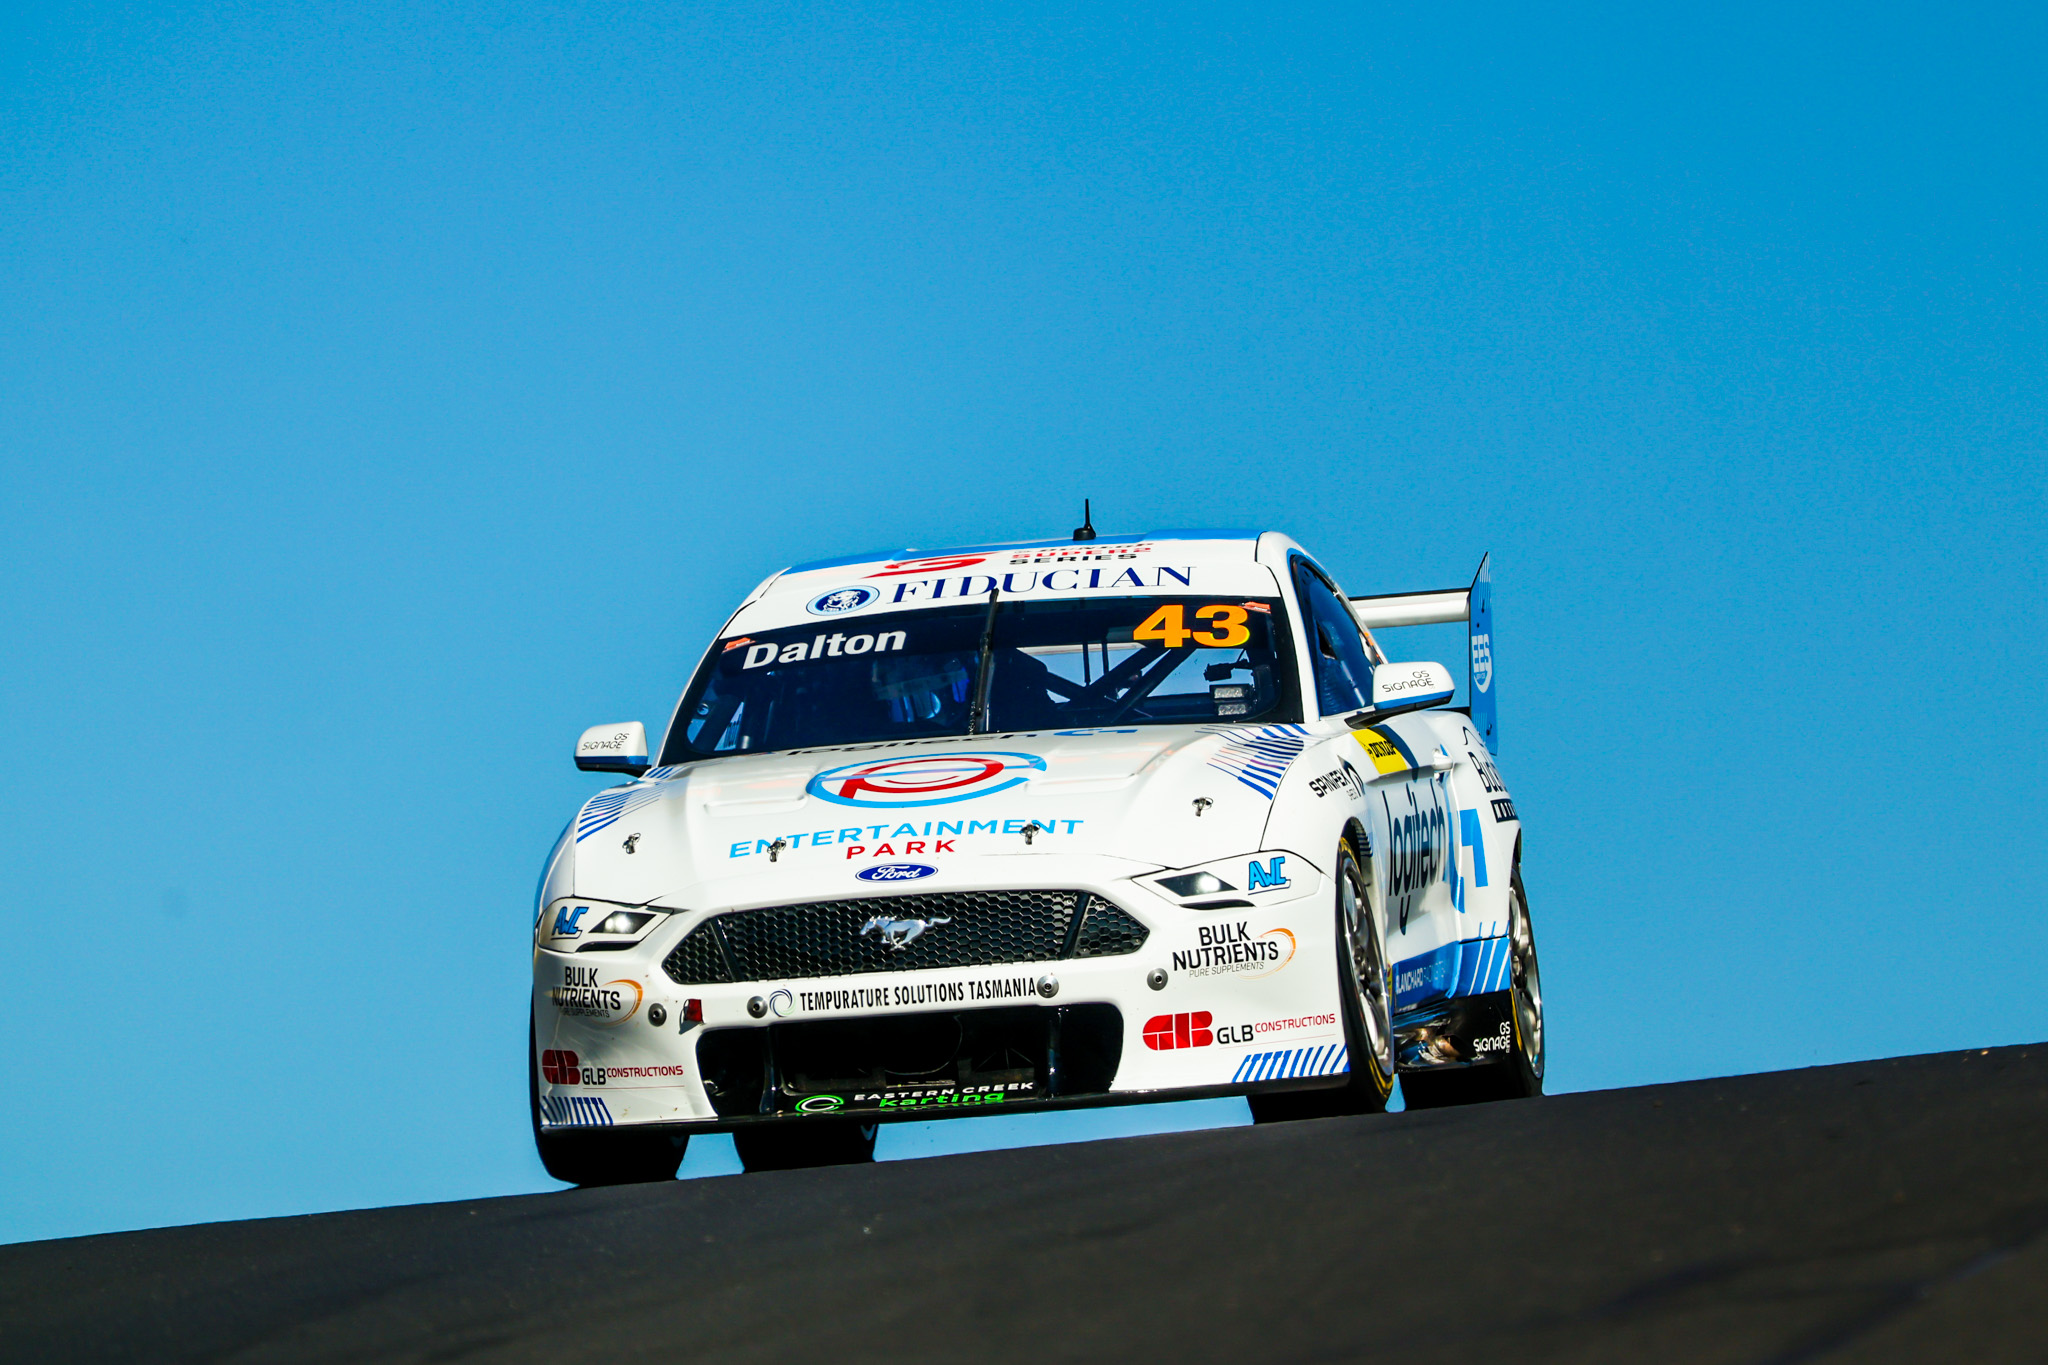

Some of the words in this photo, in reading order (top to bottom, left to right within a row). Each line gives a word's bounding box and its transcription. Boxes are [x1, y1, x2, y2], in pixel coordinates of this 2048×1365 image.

[1009, 553, 1138, 566] SERIES
[886, 566, 1197, 605] FIDUCIAN
[1133, 604, 1250, 648] 43
[742, 630, 907, 670] Dalton
[1412, 670, 1430, 679] GS
[728, 819, 1085, 859] ENTERTAINMENT
[846, 839, 957, 860] PARK
[1382, 778, 1446, 936] logitech
[869, 864, 922, 882] Ford
[1198, 921, 1251, 947] BULK
[1172, 941, 1279, 972] NUTRIENTS
[564, 966, 598, 988] BULK
[1189, 967, 1210, 979] PURE
[1211, 962, 1265, 975] SUPPLEMENTS
[552, 985, 621, 1011] NUTRIENTS
[800, 987, 890, 1012] TEMPURATURE
[895, 981, 964, 1006] SOLUTIONS
[969, 976, 1037, 1000] TASMANIA
[1216, 1024, 1255, 1045] GLB
[1255, 1013, 1336, 1034] CONSTRUCTIONS
[1499, 1021, 1510, 1035] GS
[582, 1067, 606, 1086] GLB
[606, 1065, 684, 1078] CONSTRUCTIONS
[853, 1088, 955, 1101] EASTERN
[962, 1082, 1034, 1094] CREEK
[878, 1092, 1005, 1108] karting
